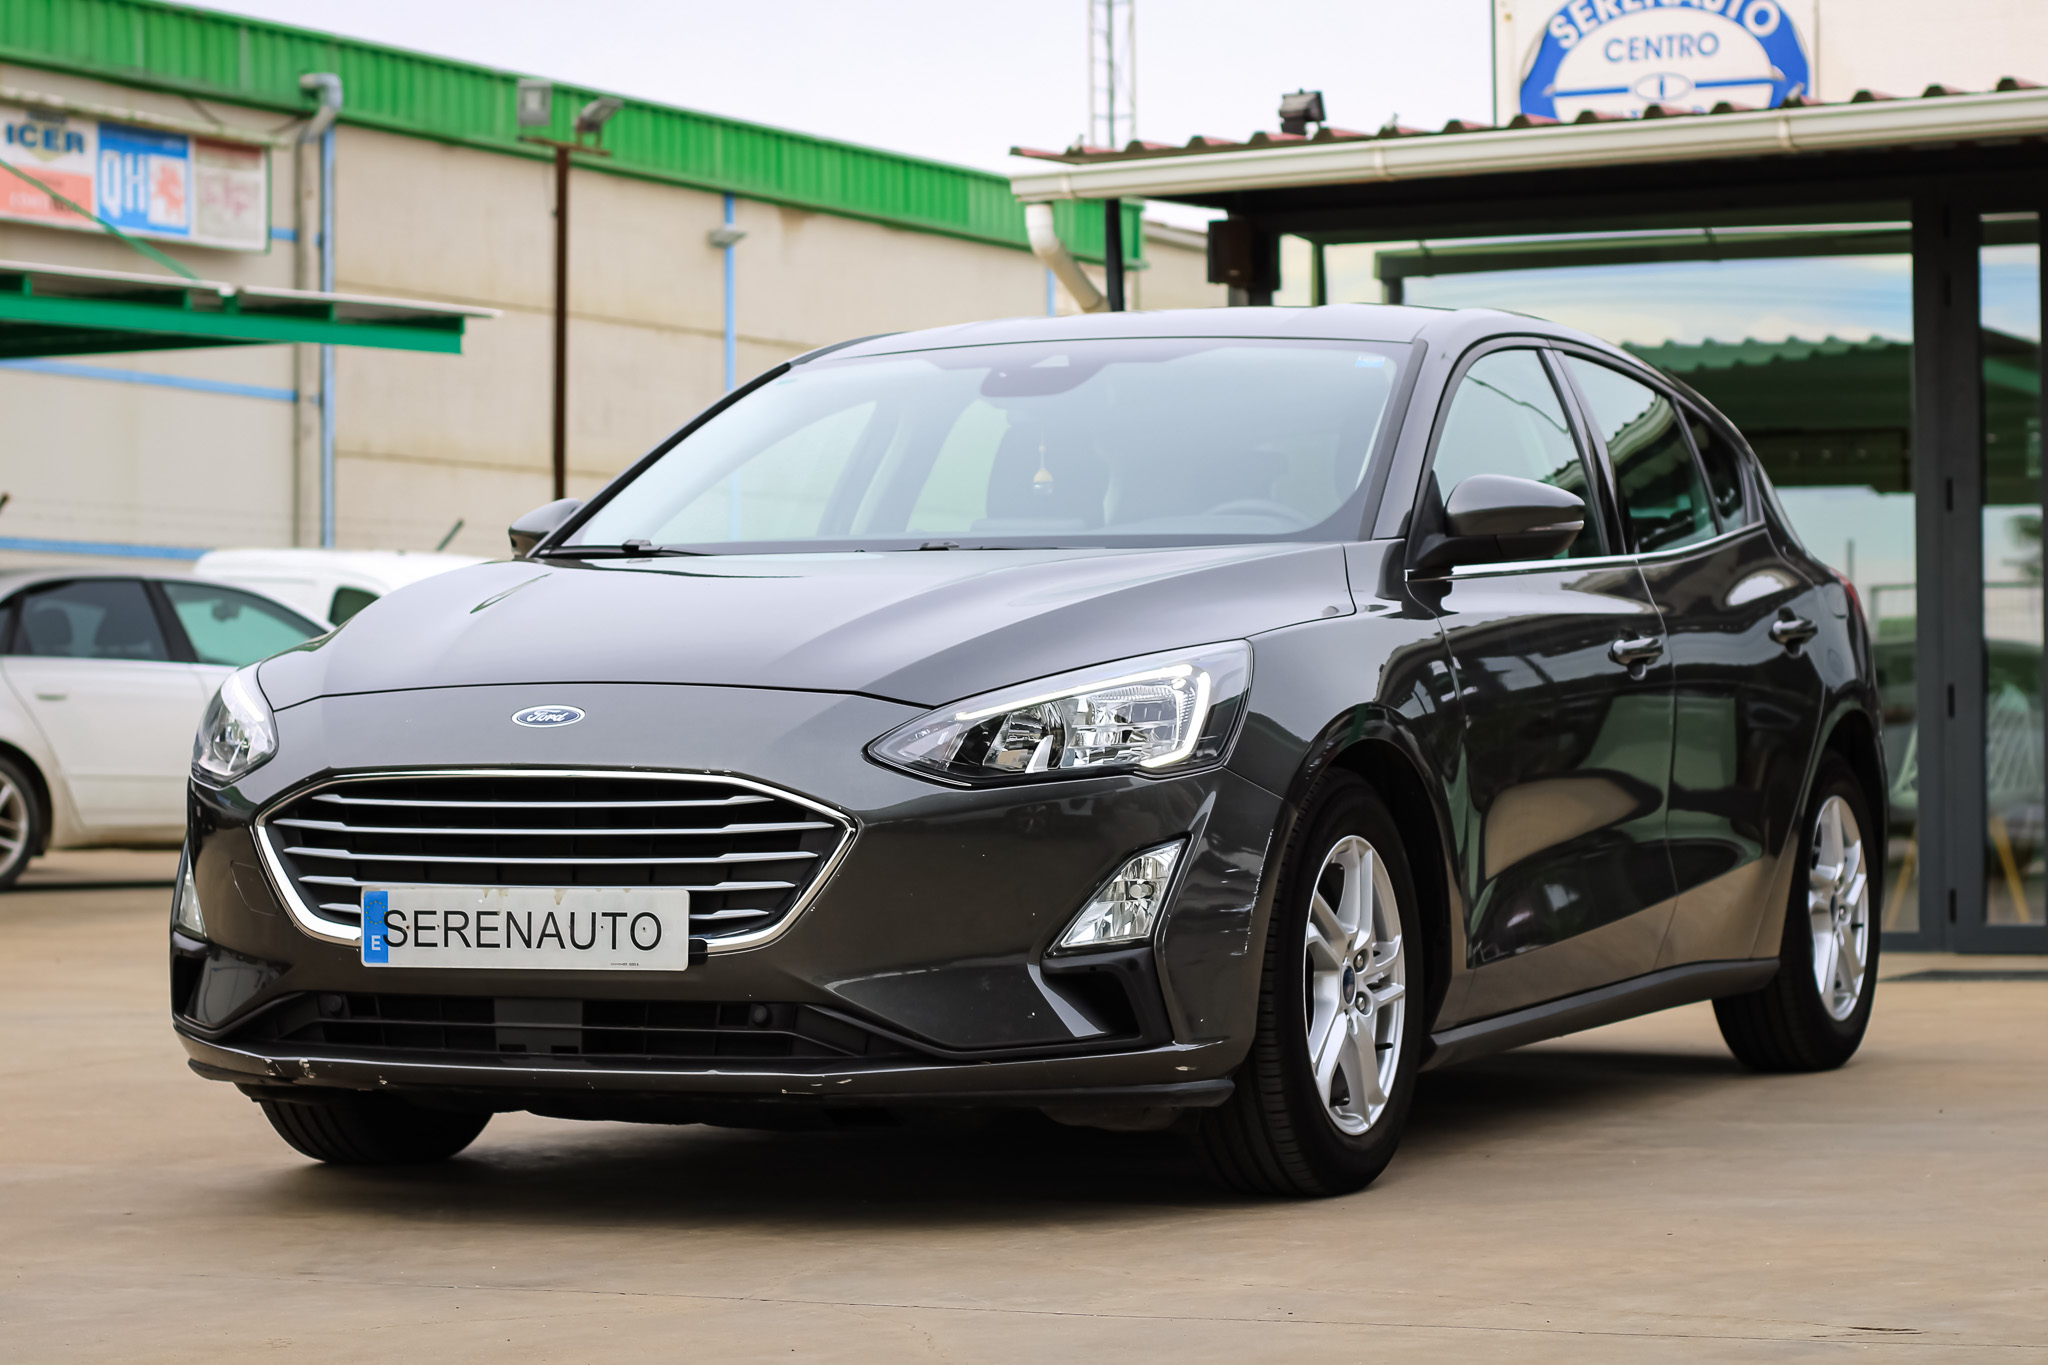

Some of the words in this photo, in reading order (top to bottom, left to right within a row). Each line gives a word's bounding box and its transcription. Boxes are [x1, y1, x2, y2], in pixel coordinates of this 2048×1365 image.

[1549, 0, 1781, 49] SERTO
[1604, 32, 1720, 63] CENTRO
[526, 709, 569, 722] Ford
[371, 935, 382, 951] E
